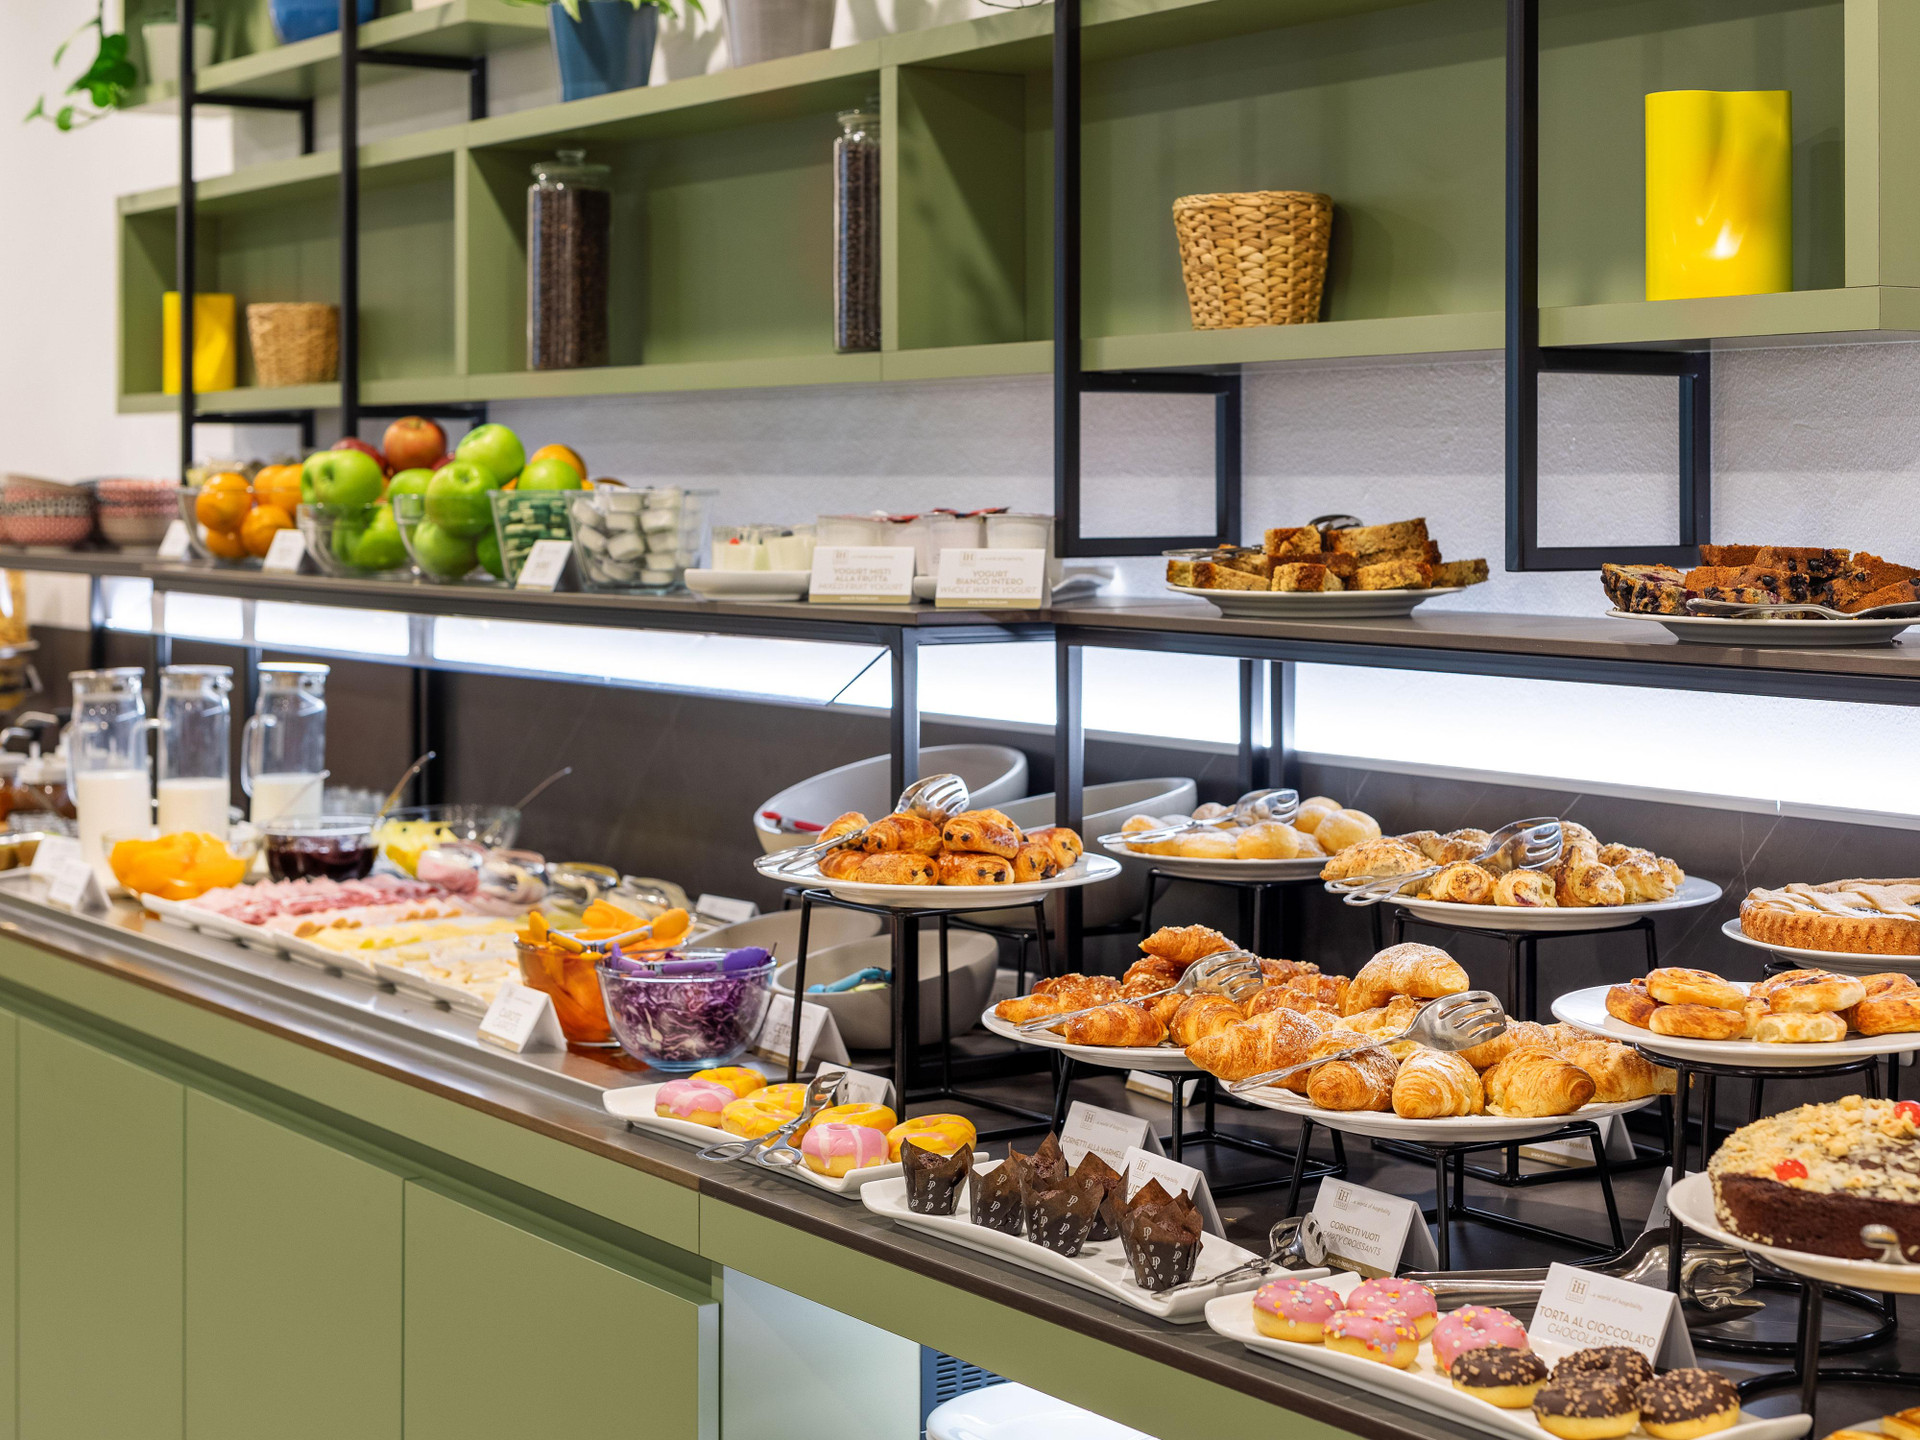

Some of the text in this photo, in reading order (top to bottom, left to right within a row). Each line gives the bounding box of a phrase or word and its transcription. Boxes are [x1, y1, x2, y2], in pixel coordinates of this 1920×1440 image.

[1062, 1135, 1125, 1160] CORNETTI ALLA MARMELL
[1322, 1230, 1382, 1256] EMPTY CROISSANTS
[1330, 1220, 1380, 1242] CORNETTI VUOTI
[1539, 1305, 1570, 1323] TORTA
[1572, 1315, 1583, 1328] AL
[1587, 1320, 1656, 1348] CIOCCOLATO
[1547, 1322, 1609, 1348] CHOCOLATE
